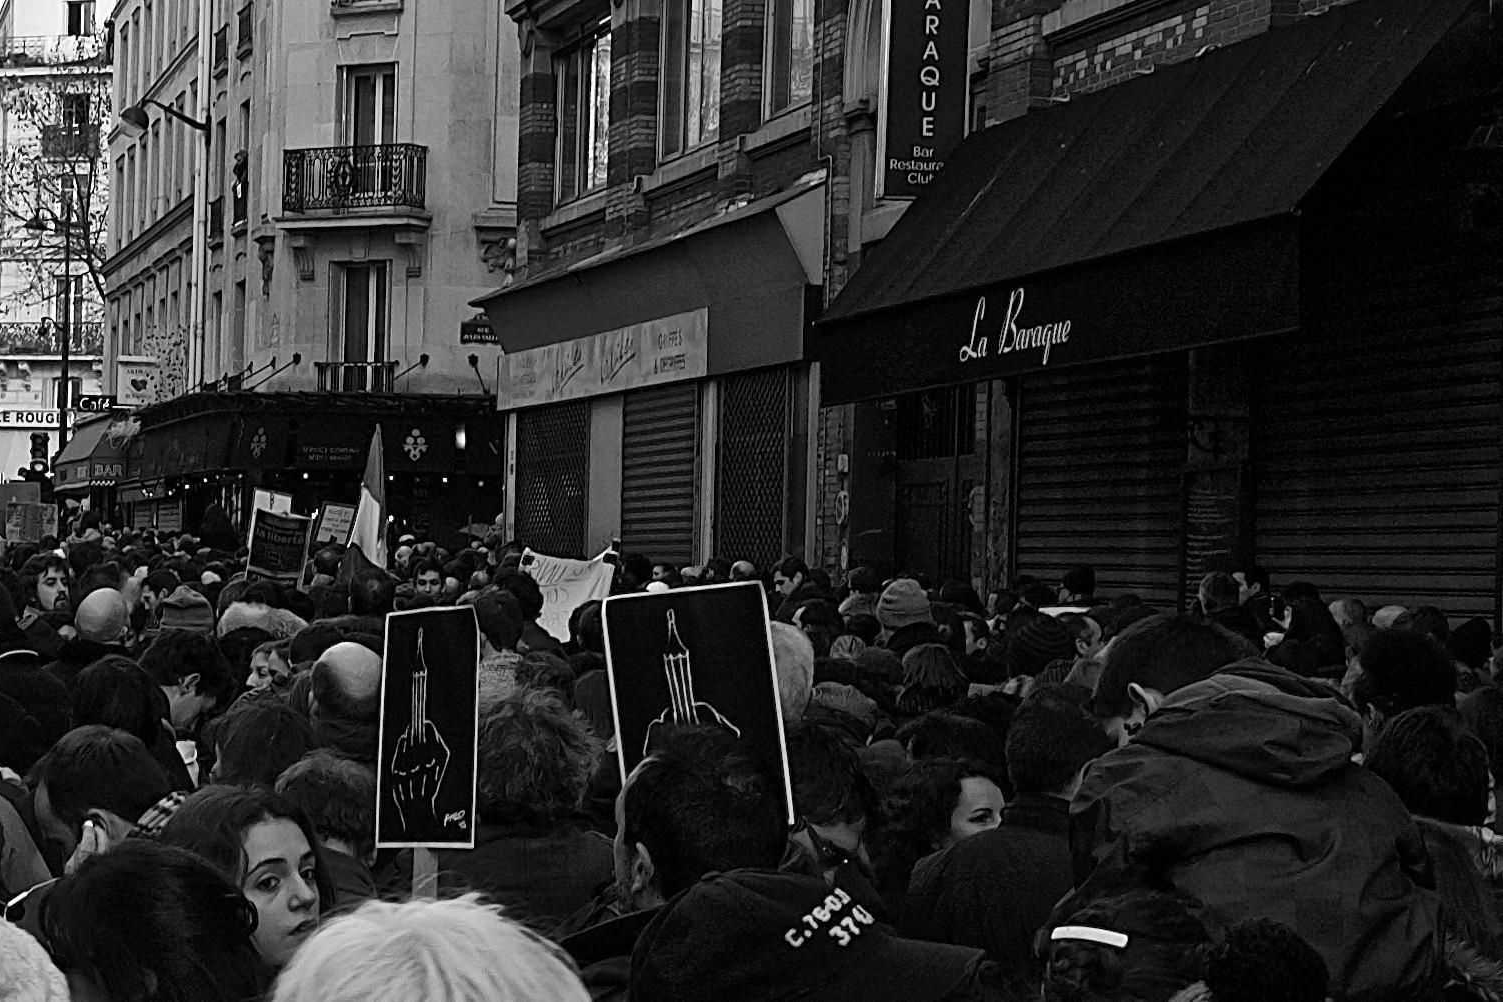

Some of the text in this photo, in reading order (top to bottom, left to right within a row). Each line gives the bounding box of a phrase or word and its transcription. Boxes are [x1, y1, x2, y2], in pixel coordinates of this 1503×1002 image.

[913, 145, 935, 158] Bar
[959, 287, 1072, 366] La Baraque
[79, 396, 111, 412] Café
[94, 463, 123, 477] BAR
